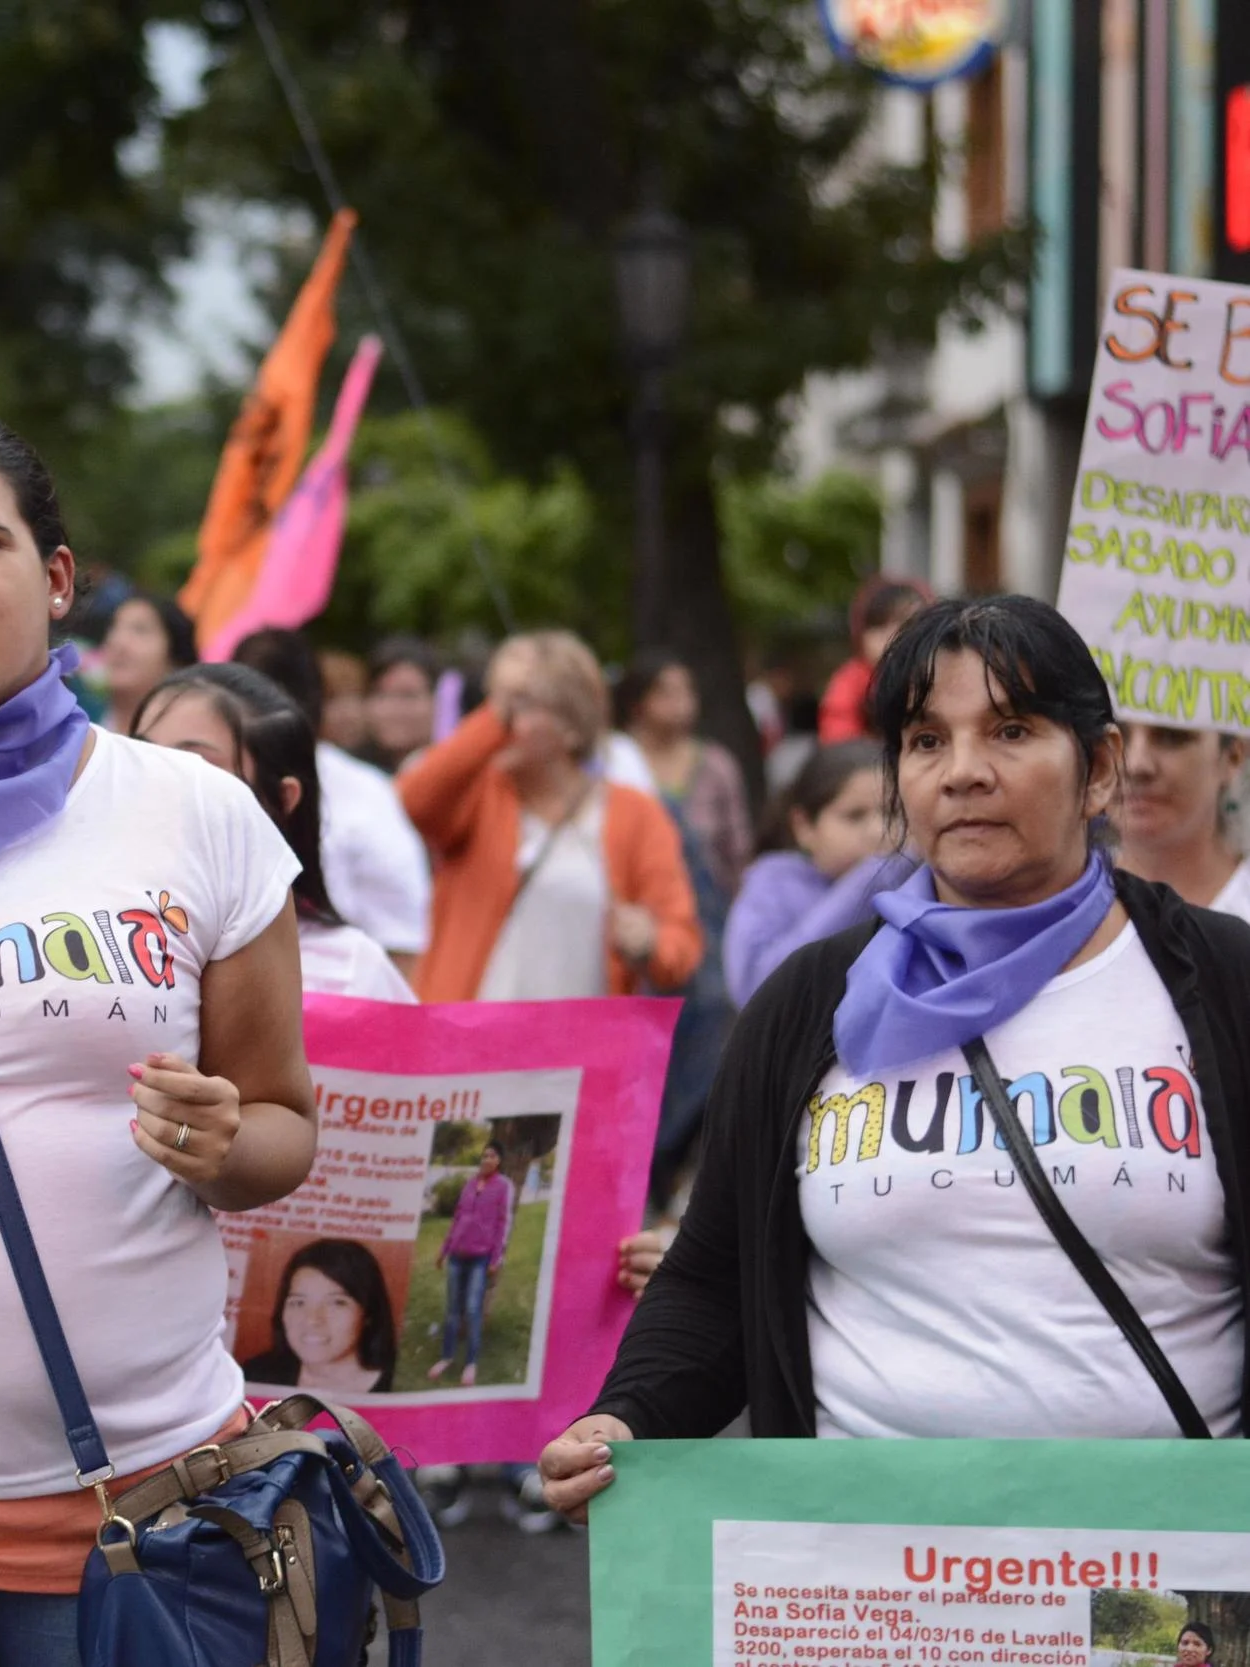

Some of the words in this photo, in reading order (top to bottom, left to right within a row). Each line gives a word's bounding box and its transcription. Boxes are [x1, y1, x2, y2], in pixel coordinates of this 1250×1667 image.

[1106, 284, 1198, 371] SE
[1067, 522, 1236, 588] SABADO
[1089, 645, 1250, 728] NCONTR
[806, 1064, 1202, 1174] mumala
[831, 1161, 1186, 1204] TUCUMÁN
[904, 1546, 1159, 1593] Urgente!!!
[734, 1582, 758, 1598] Se
[764, 1585, 849, 1600] necesita
[855, 1586, 912, 1602] saber
[918, 1588, 936, 1603] el
[941, 1589, 1036, 1607] paradero
[1041, 1590, 1067, 1607] de
[734, 1600, 779, 1619] Ana
[786, 1601, 846, 1621] Sofia
[853, 1604, 921, 1627] Vega.
[734, 1621, 860, 1641] Desapareció
[866, 1626, 883, 1641] el
[889, 1627, 975, 1643] 04/03/16
[981, 1629, 1006, 1645] de
[1012, 1630, 1084, 1647] Lavalle
[734, 1640, 787, 1658] 3200,
[794, 1644, 888, 1661] esperaba
[894, 1646, 912, 1661] el
[918, 1646, 942, 1661] 10
[948, 1650, 985, 1663] con
[990, 1648, 1087, 1666] dirección
